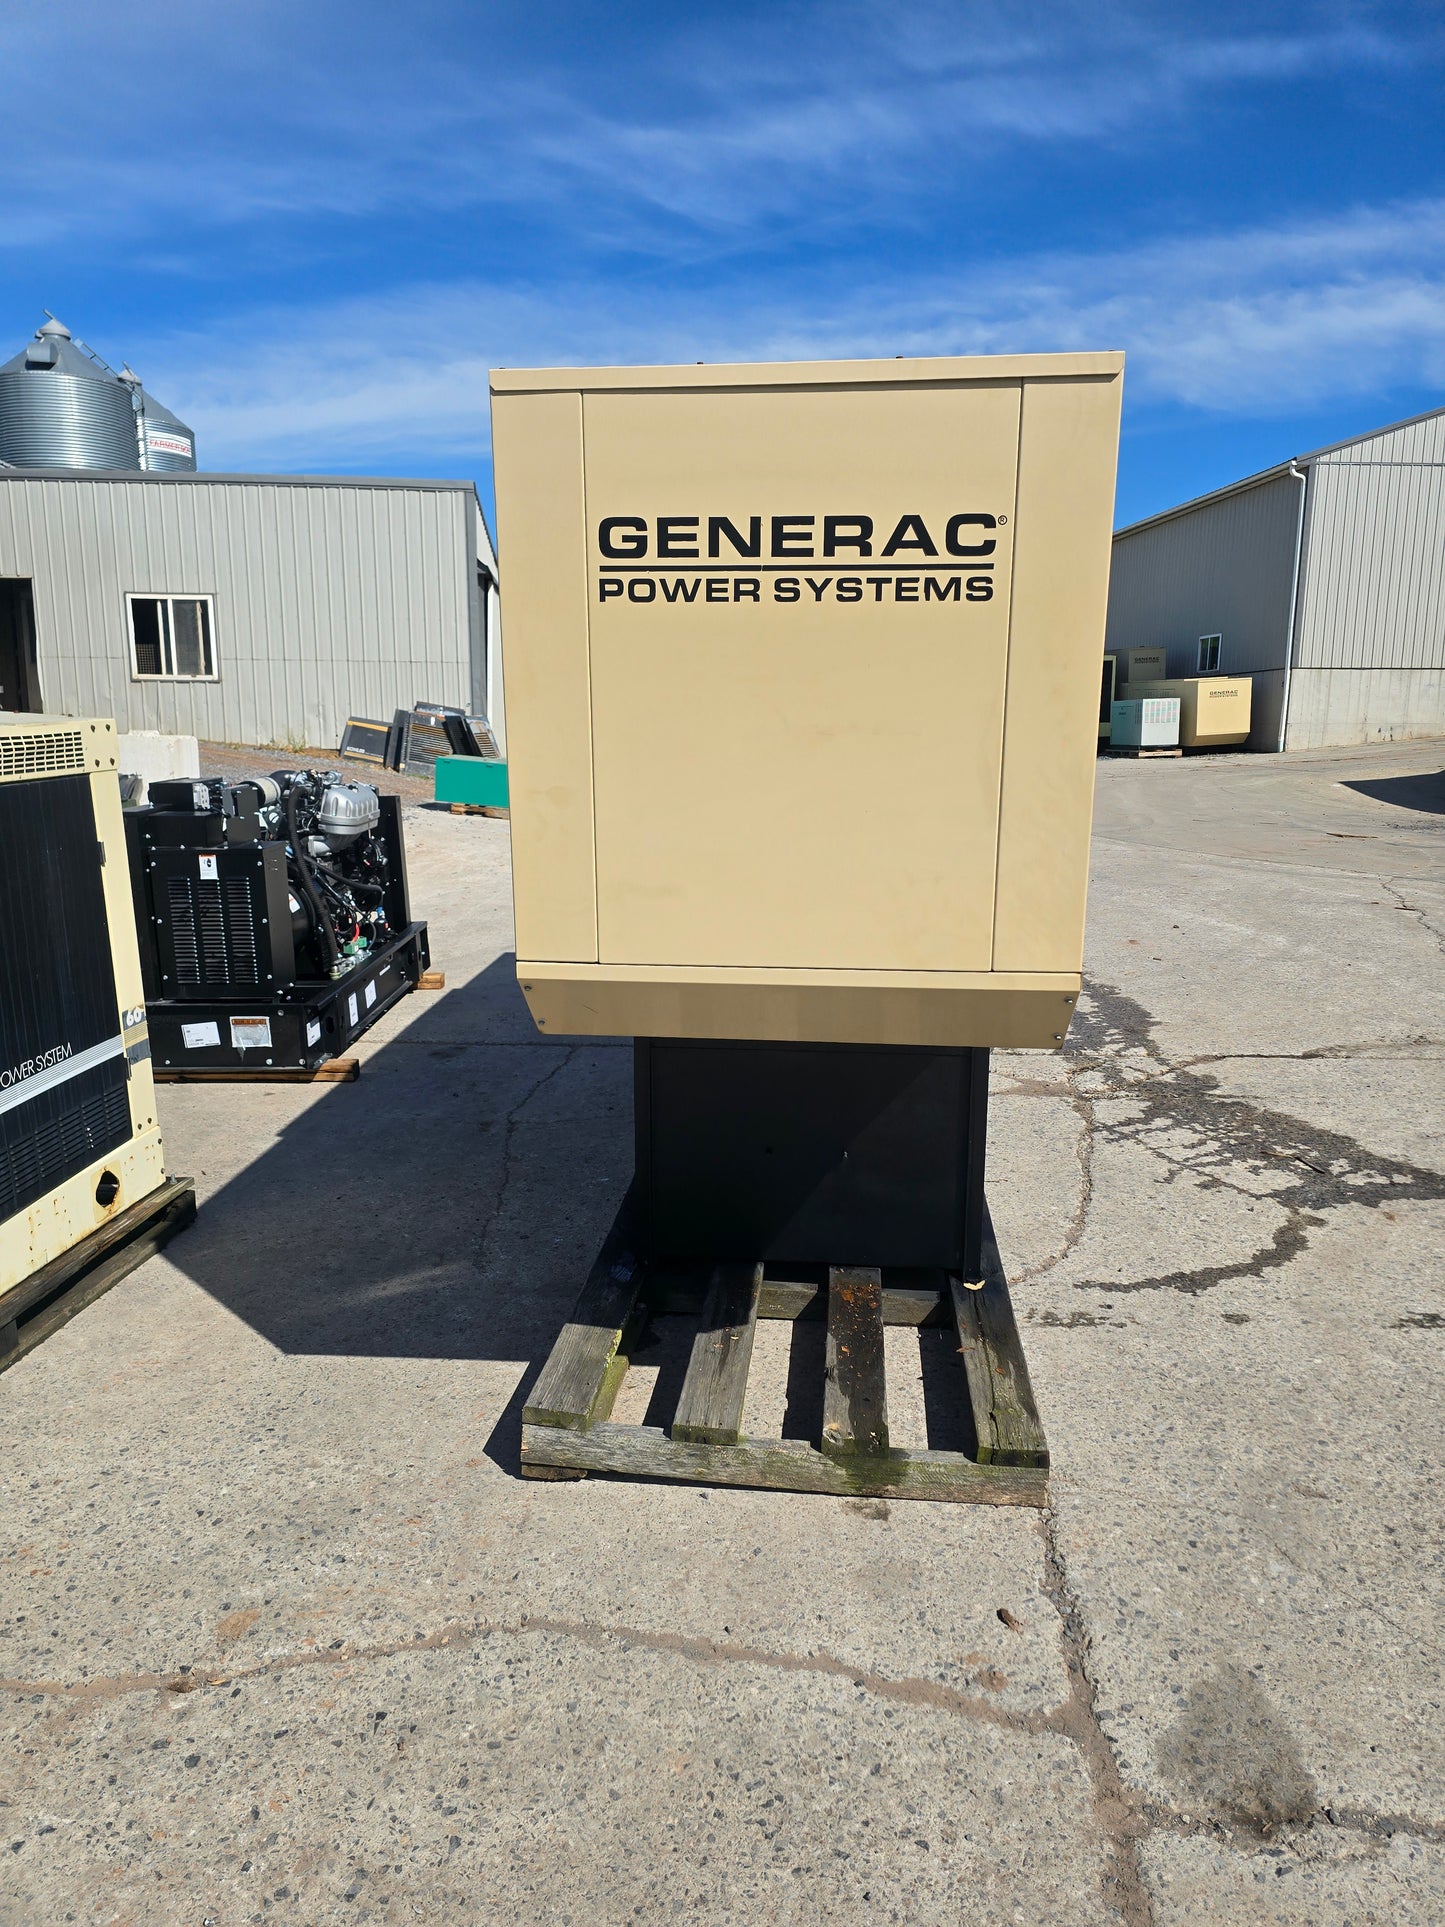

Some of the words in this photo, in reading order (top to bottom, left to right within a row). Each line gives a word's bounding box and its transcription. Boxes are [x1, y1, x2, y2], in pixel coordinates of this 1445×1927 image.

[598, 577, 761, 602] POWER
[773, 576, 994, 602] SYSTEMS
[126, 1006, 142, 1027] 60
[0, 1060, 35, 1088] OWER
[35, 1042, 73, 1072] SYSTEM
